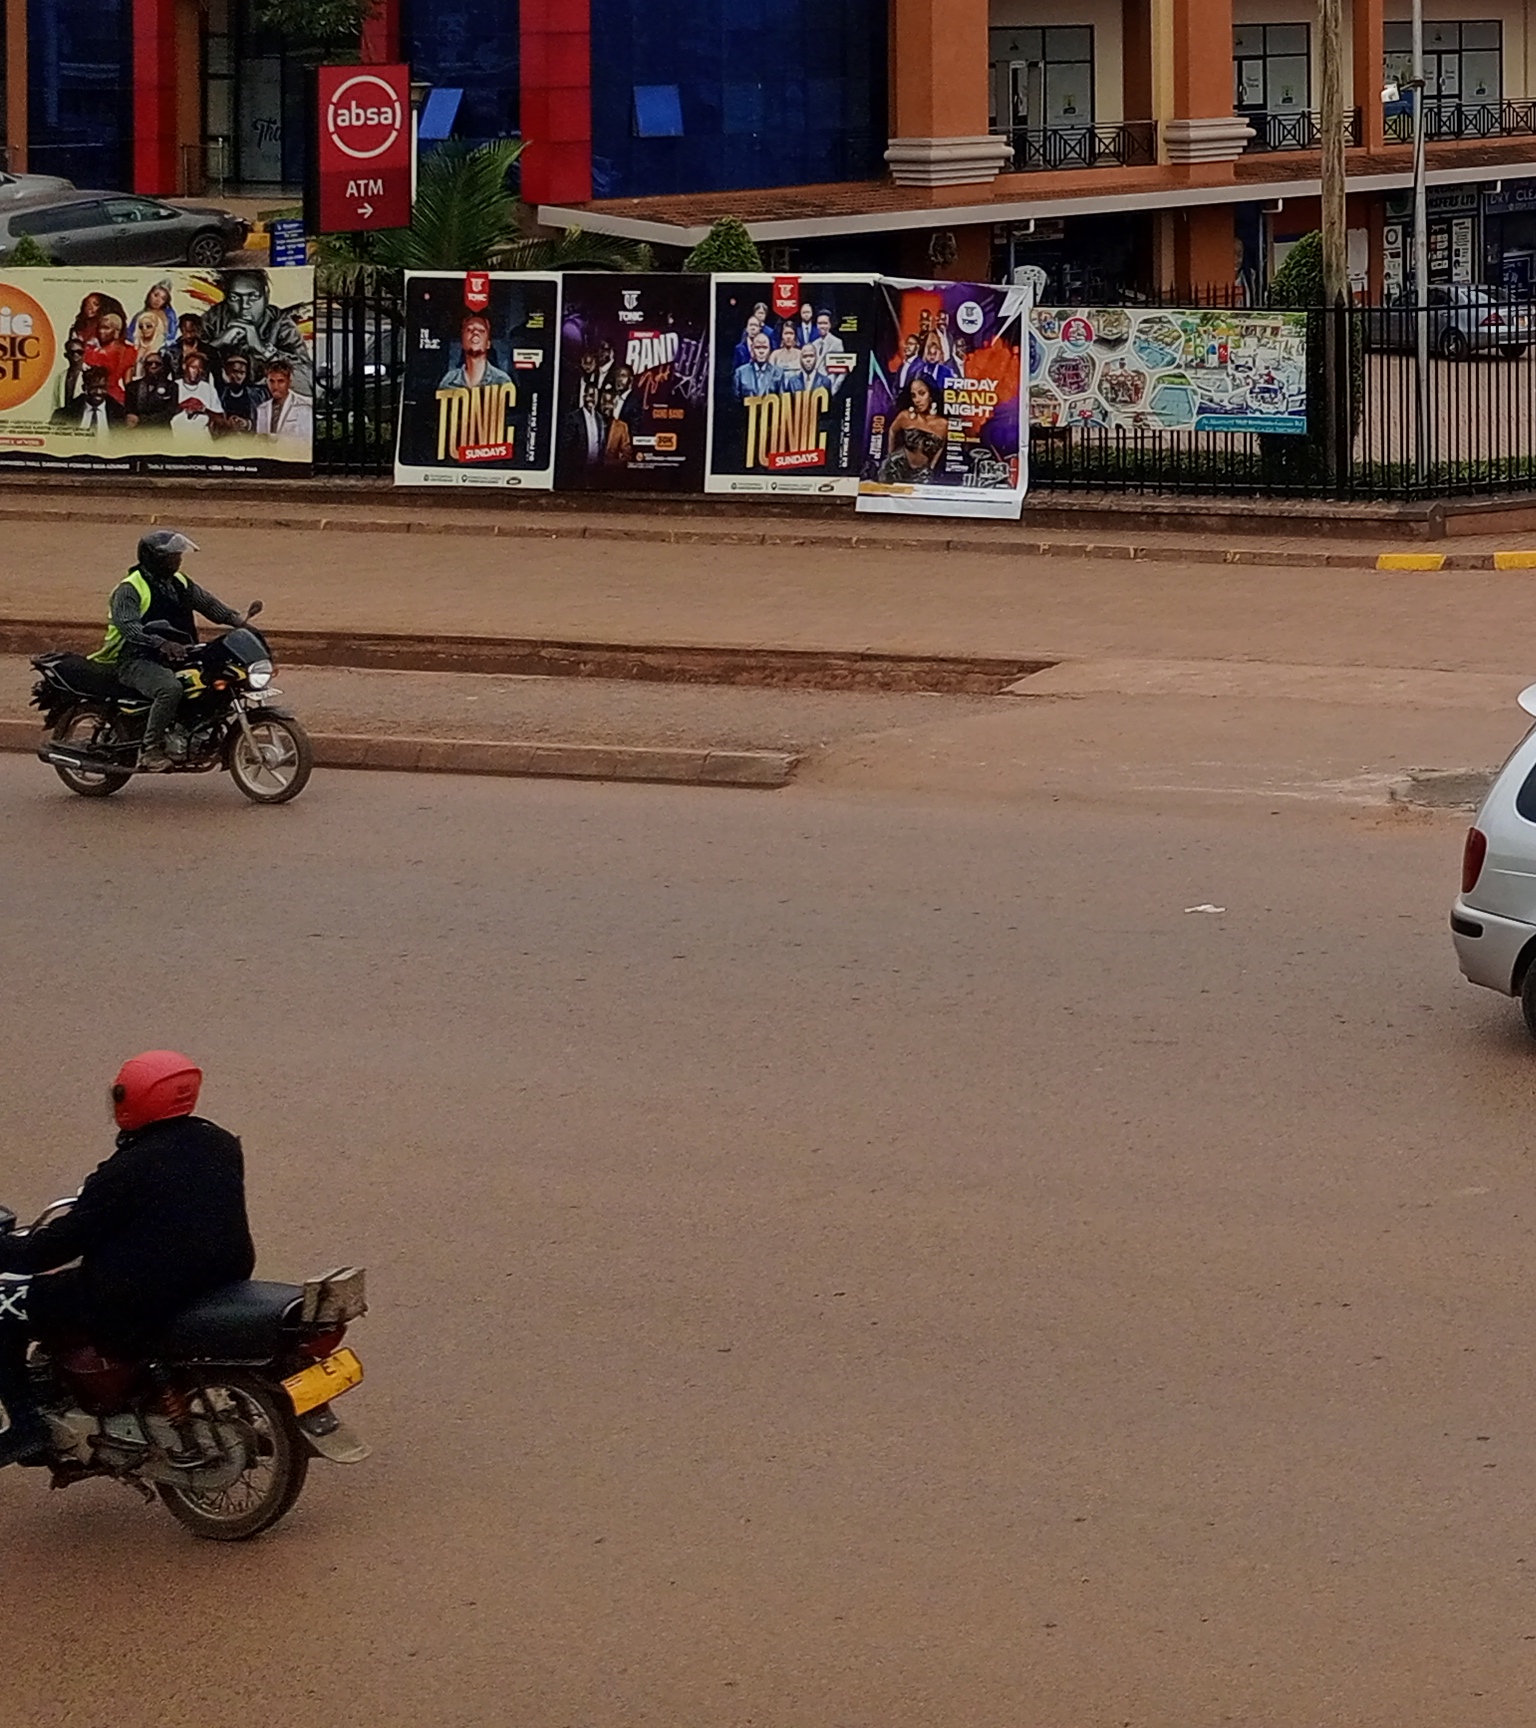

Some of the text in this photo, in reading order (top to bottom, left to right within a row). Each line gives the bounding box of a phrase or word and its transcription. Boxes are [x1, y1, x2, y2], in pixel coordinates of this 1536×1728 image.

[337, 101, 393, 126] absa
[345, 179, 384, 198] ATM
[1489, 192, 1510, 205] DRY
[618, 311, 644, 321] TONIC
[626, 332, 679, 375] BAND
[943, 377, 999, 391] FRIDAY
[943, 390, 998, 405] BAND
[943, 404, 994, 417] NIGHT
[435, 382, 516, 460] TONIC
[744, 386, 829, 468] TONIC
[465, 446, 506, 459] SUNDAYS
[775, 453, 819, 466] SUNDAYS
